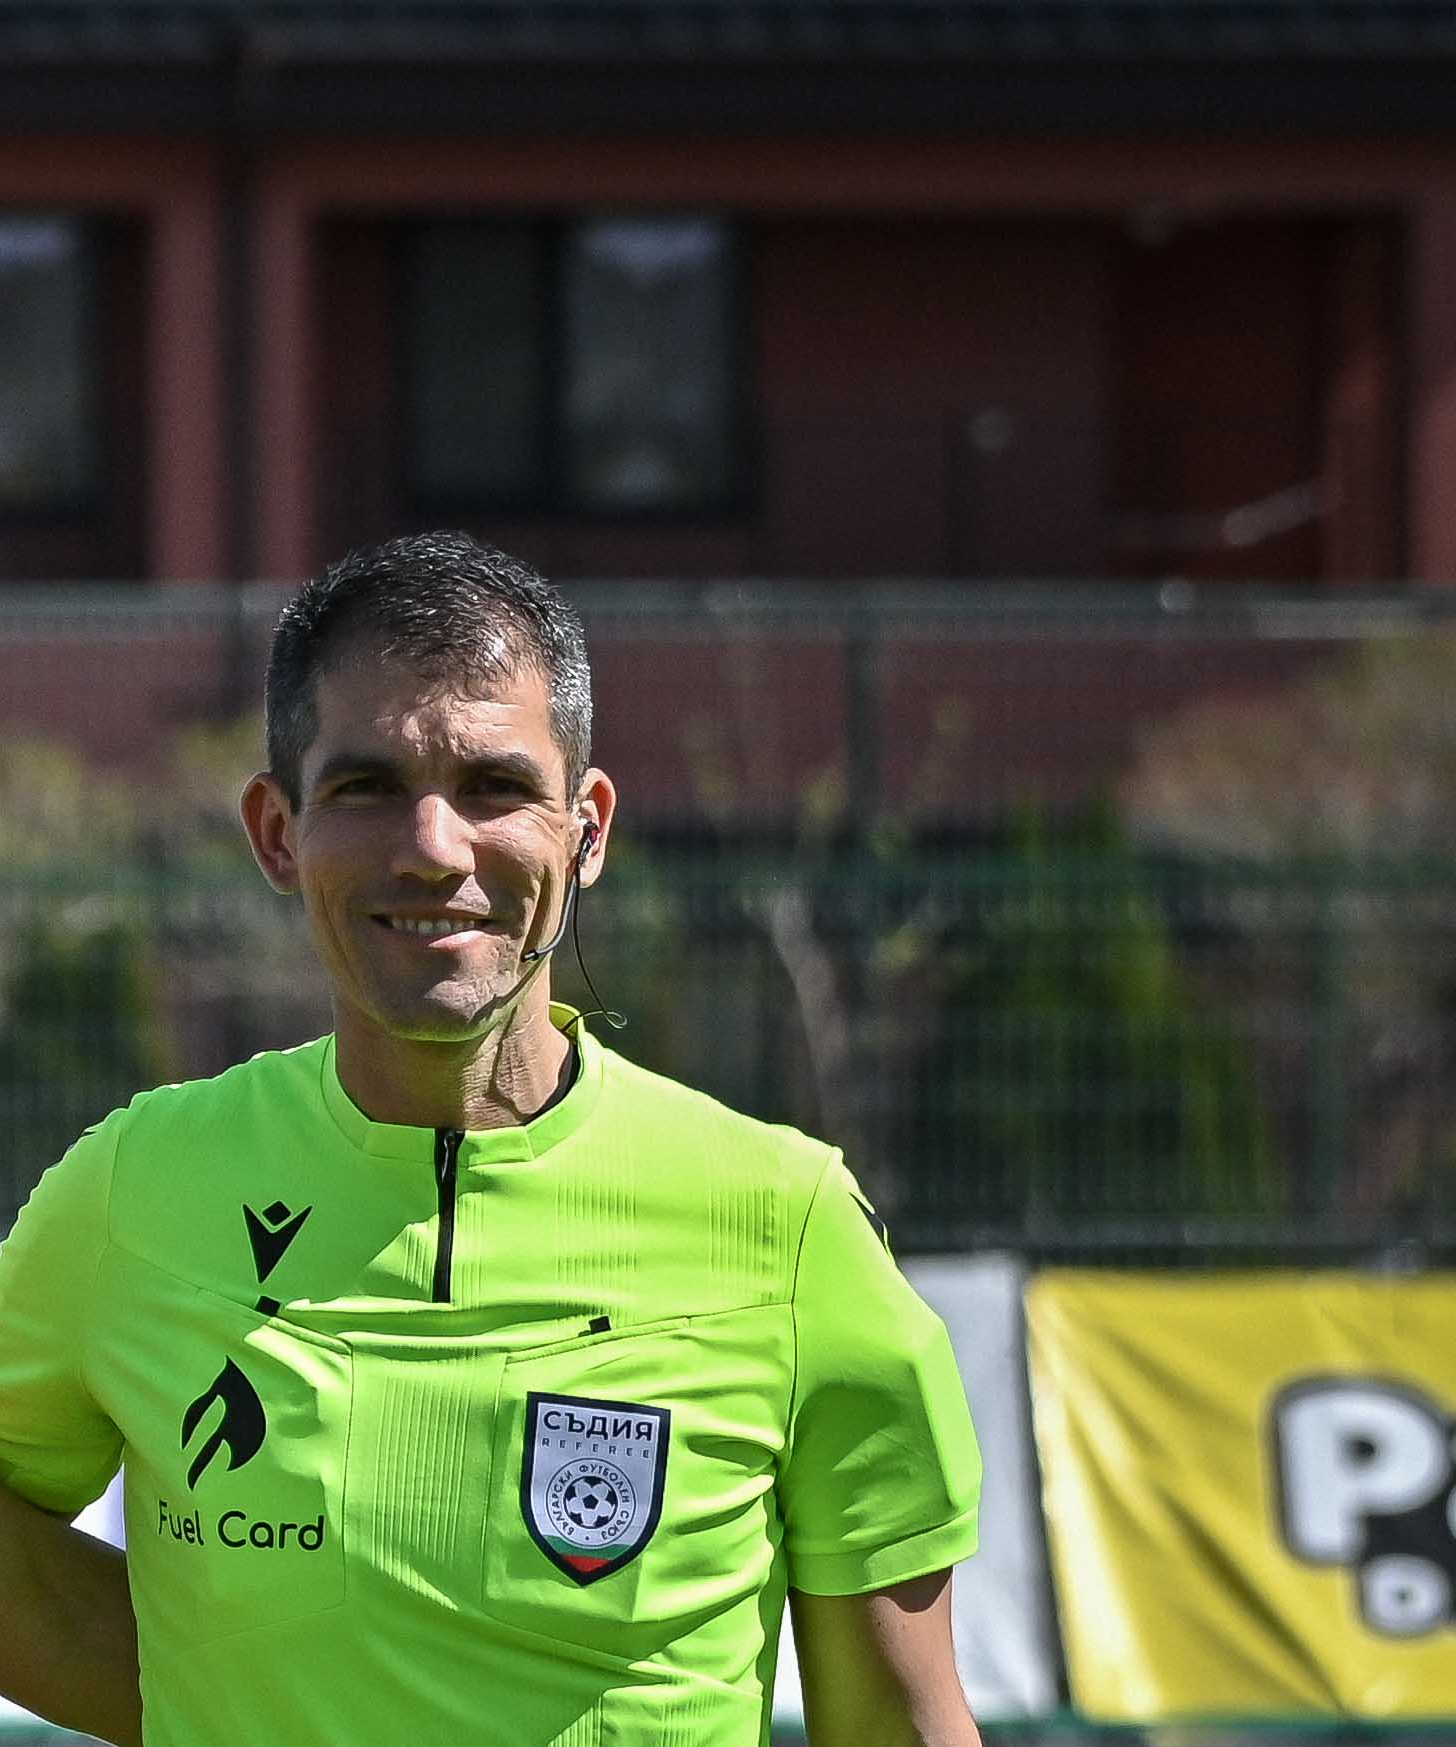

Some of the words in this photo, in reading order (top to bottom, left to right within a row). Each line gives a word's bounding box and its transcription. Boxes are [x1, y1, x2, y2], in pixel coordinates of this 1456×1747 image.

[543, 1410, 654, 1442] СЪДИЯ
[542, 1437, 650, 1459] REFEREE
[551, 1470, 576, 1537] БЪЛГАРСКИ
[579, 1463, 631, 1504] ФУТБОЛЕН
[158, 1499, 204, 1546] Fuel
[217, 1510, 325, 1551] Card
